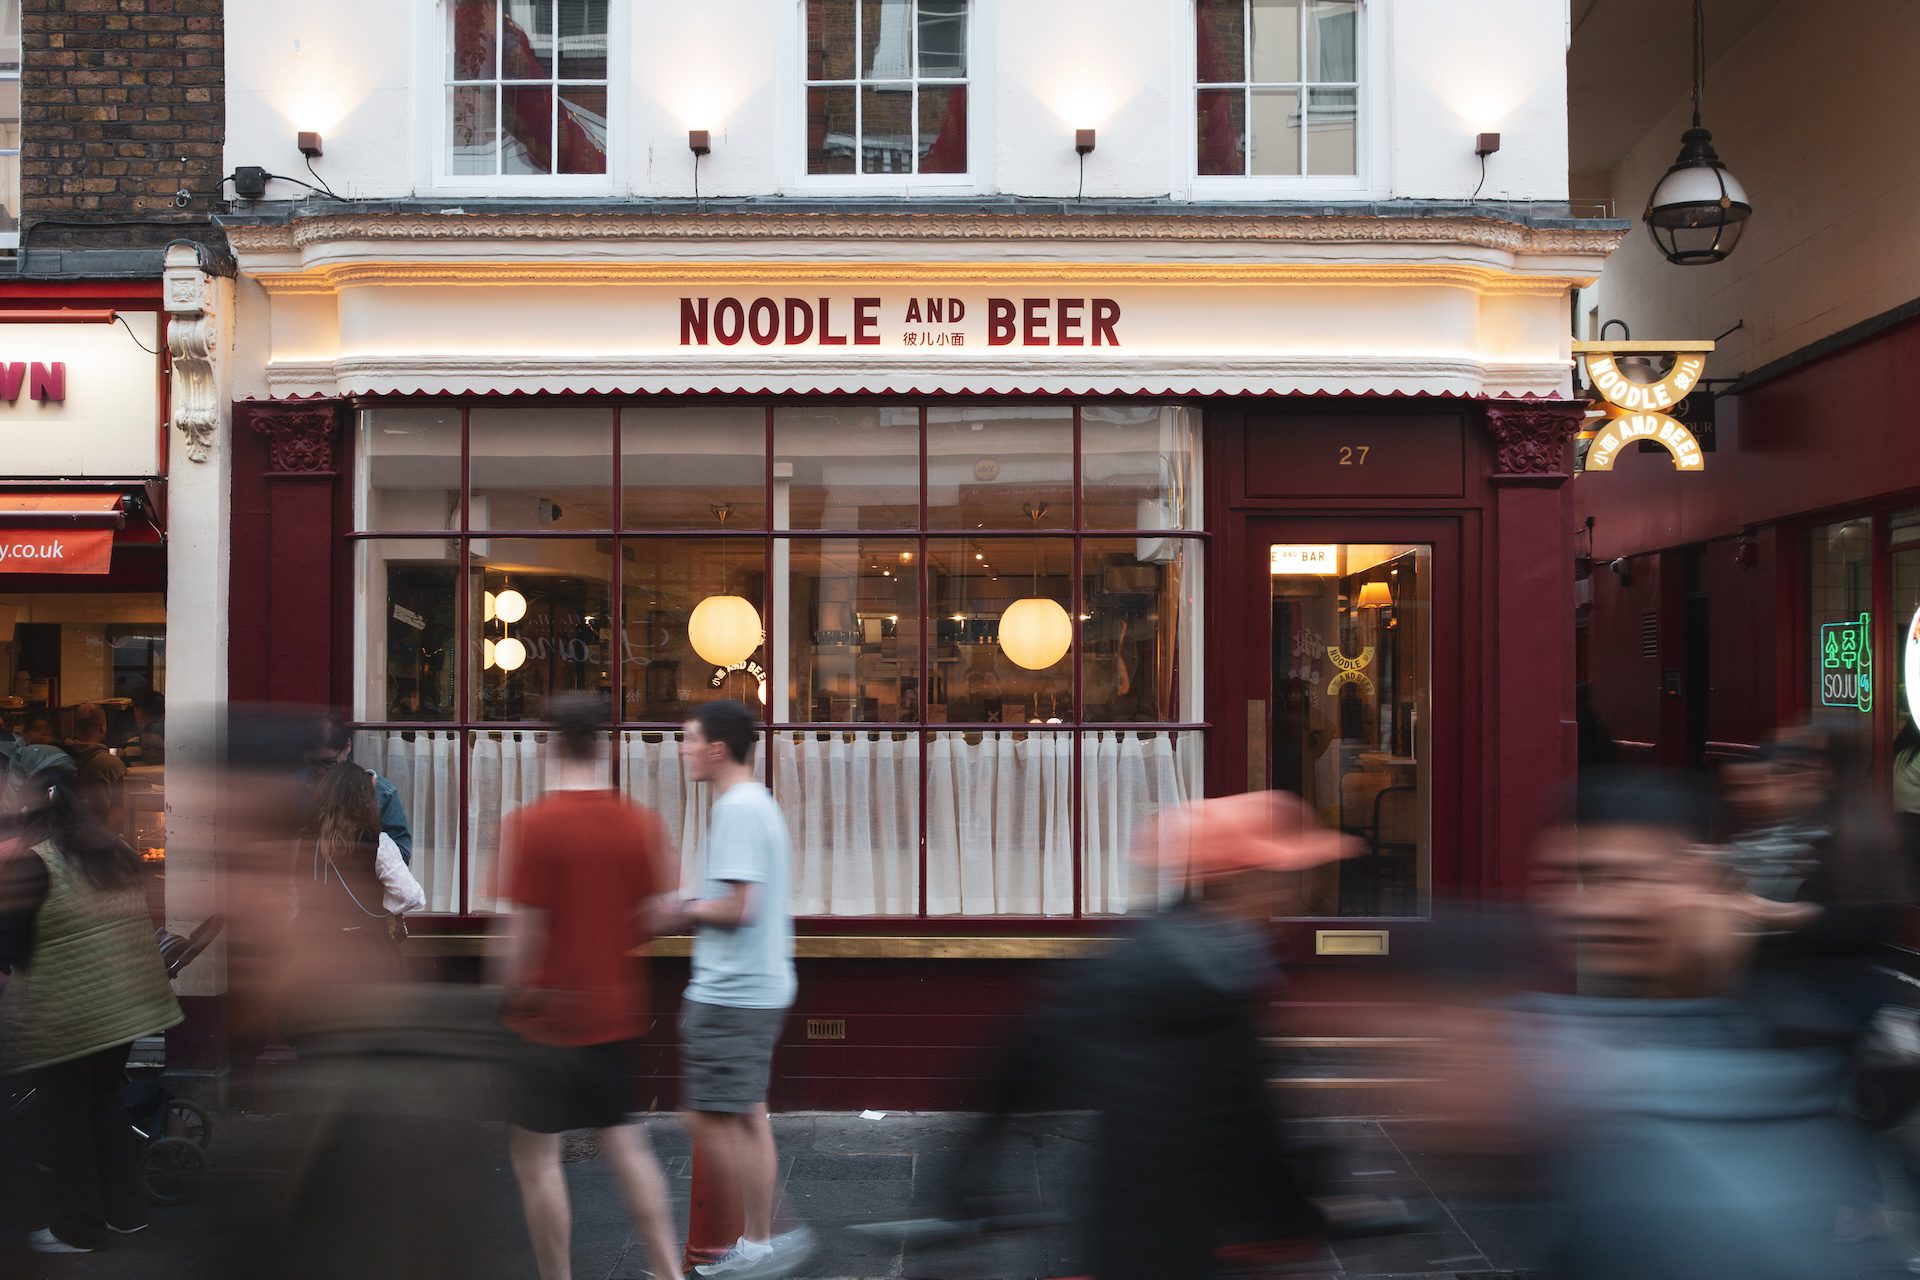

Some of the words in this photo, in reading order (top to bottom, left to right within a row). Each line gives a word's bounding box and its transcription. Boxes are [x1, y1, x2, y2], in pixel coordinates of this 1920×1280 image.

[679, 297, 881, 346] NOODLE
[905, 298, 965, 323] AND
[987, 298, 1121, 346] BEER
[903, 332, 965, 346] 彼儿小面
[1589, 357, 1672, 409] NOODLE
[1618, 415, 1658, 440] AND
[1658, 420, 1700, 468] BEER
[1339, 446, 1370, 465] 27
[1302, 551, 1325, 561] BAR
[1329, 649, 1362, 669] NOODLE
[1824, 630, 1857, 669] 소주
[1340, 672, 1356, 682] AND
[1824, 673, 1857, 699] SOJU
